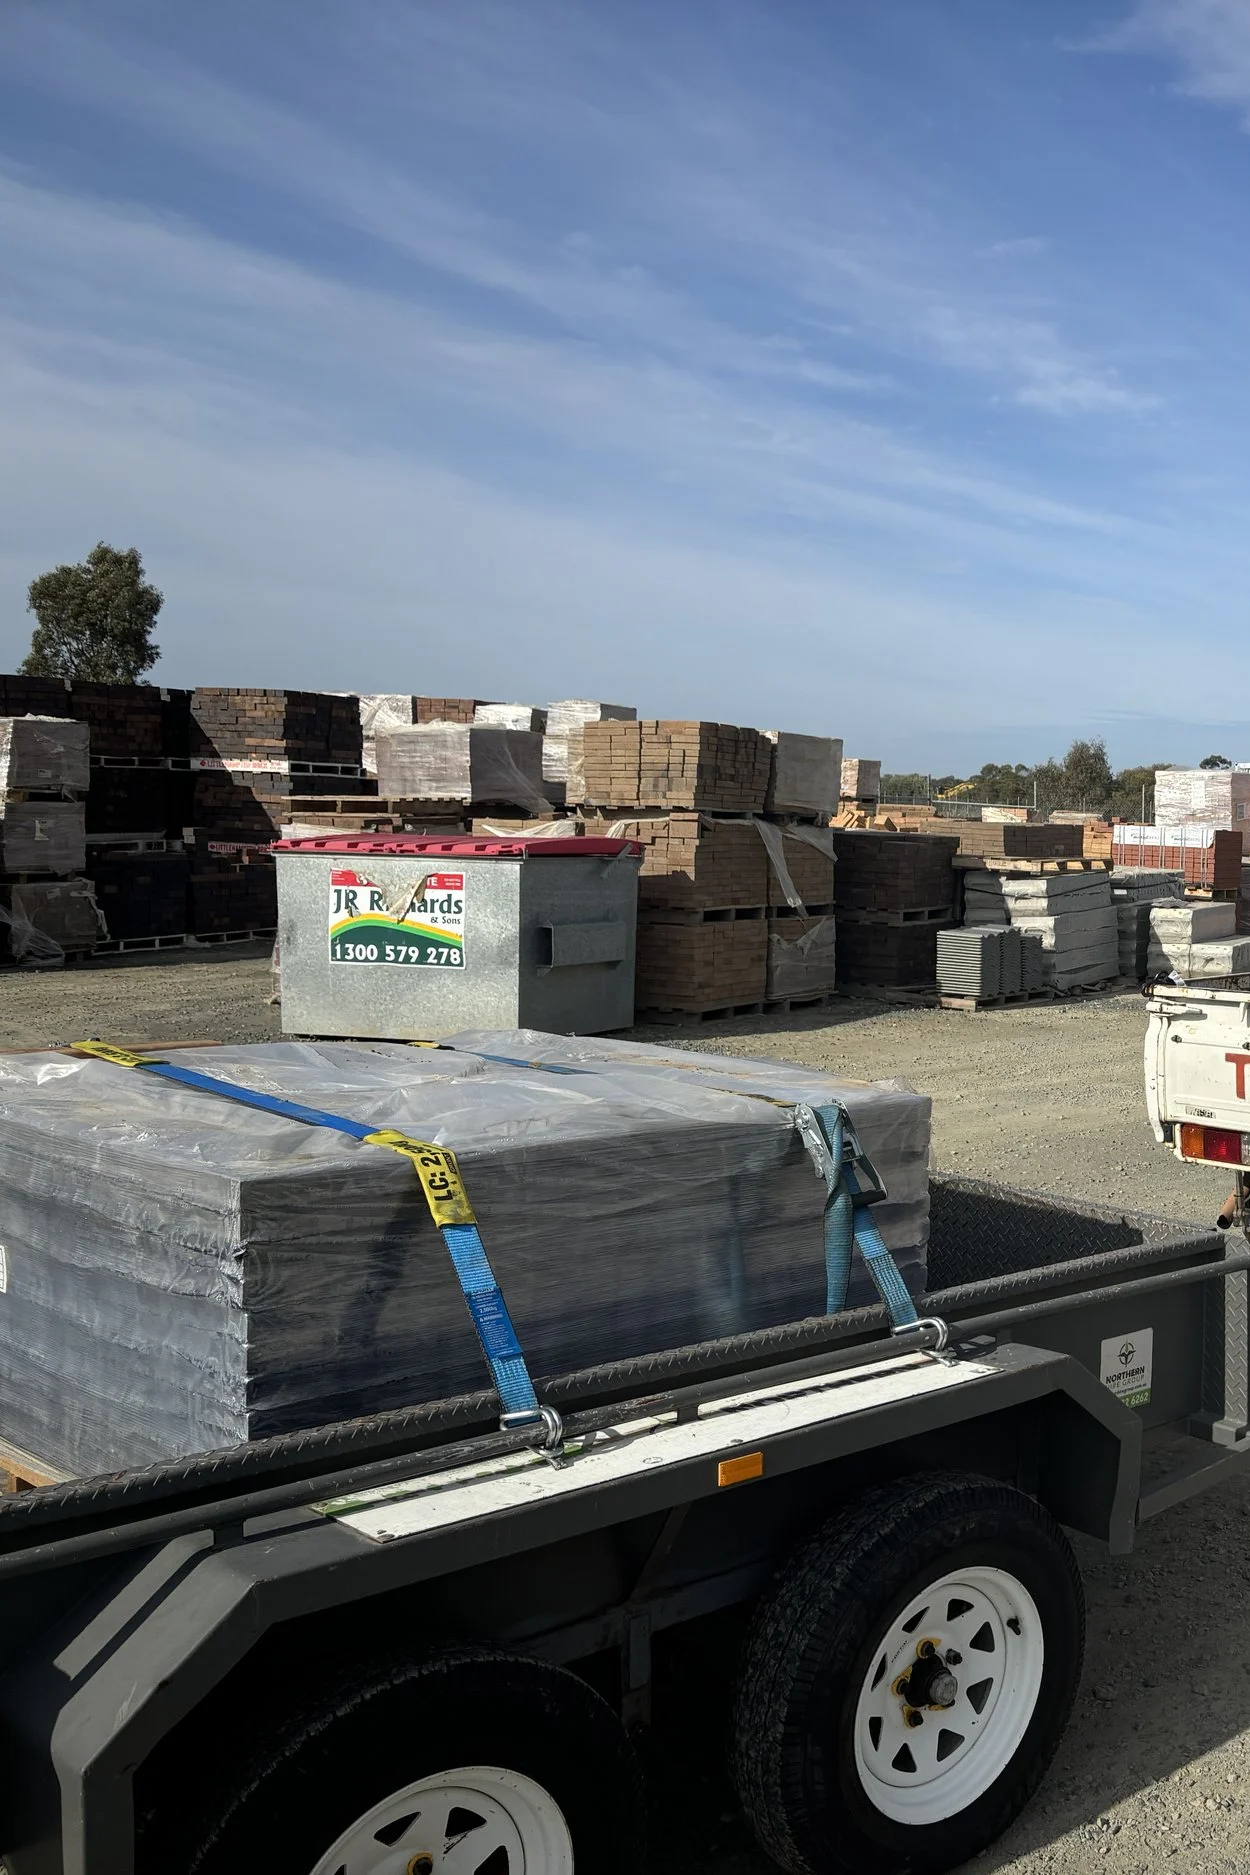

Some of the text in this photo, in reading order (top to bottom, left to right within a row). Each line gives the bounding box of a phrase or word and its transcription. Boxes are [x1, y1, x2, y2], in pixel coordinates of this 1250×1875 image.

[333, 888, 360, 914] JR
[430, 915, 461, 925] & Sons
[385, 944, 420, 963] 579
[426, 946, 461, 965] 278
[428, 1171, 454, 1202] LC:
[1105, 1365, 1145, 1385] NORTHERN
